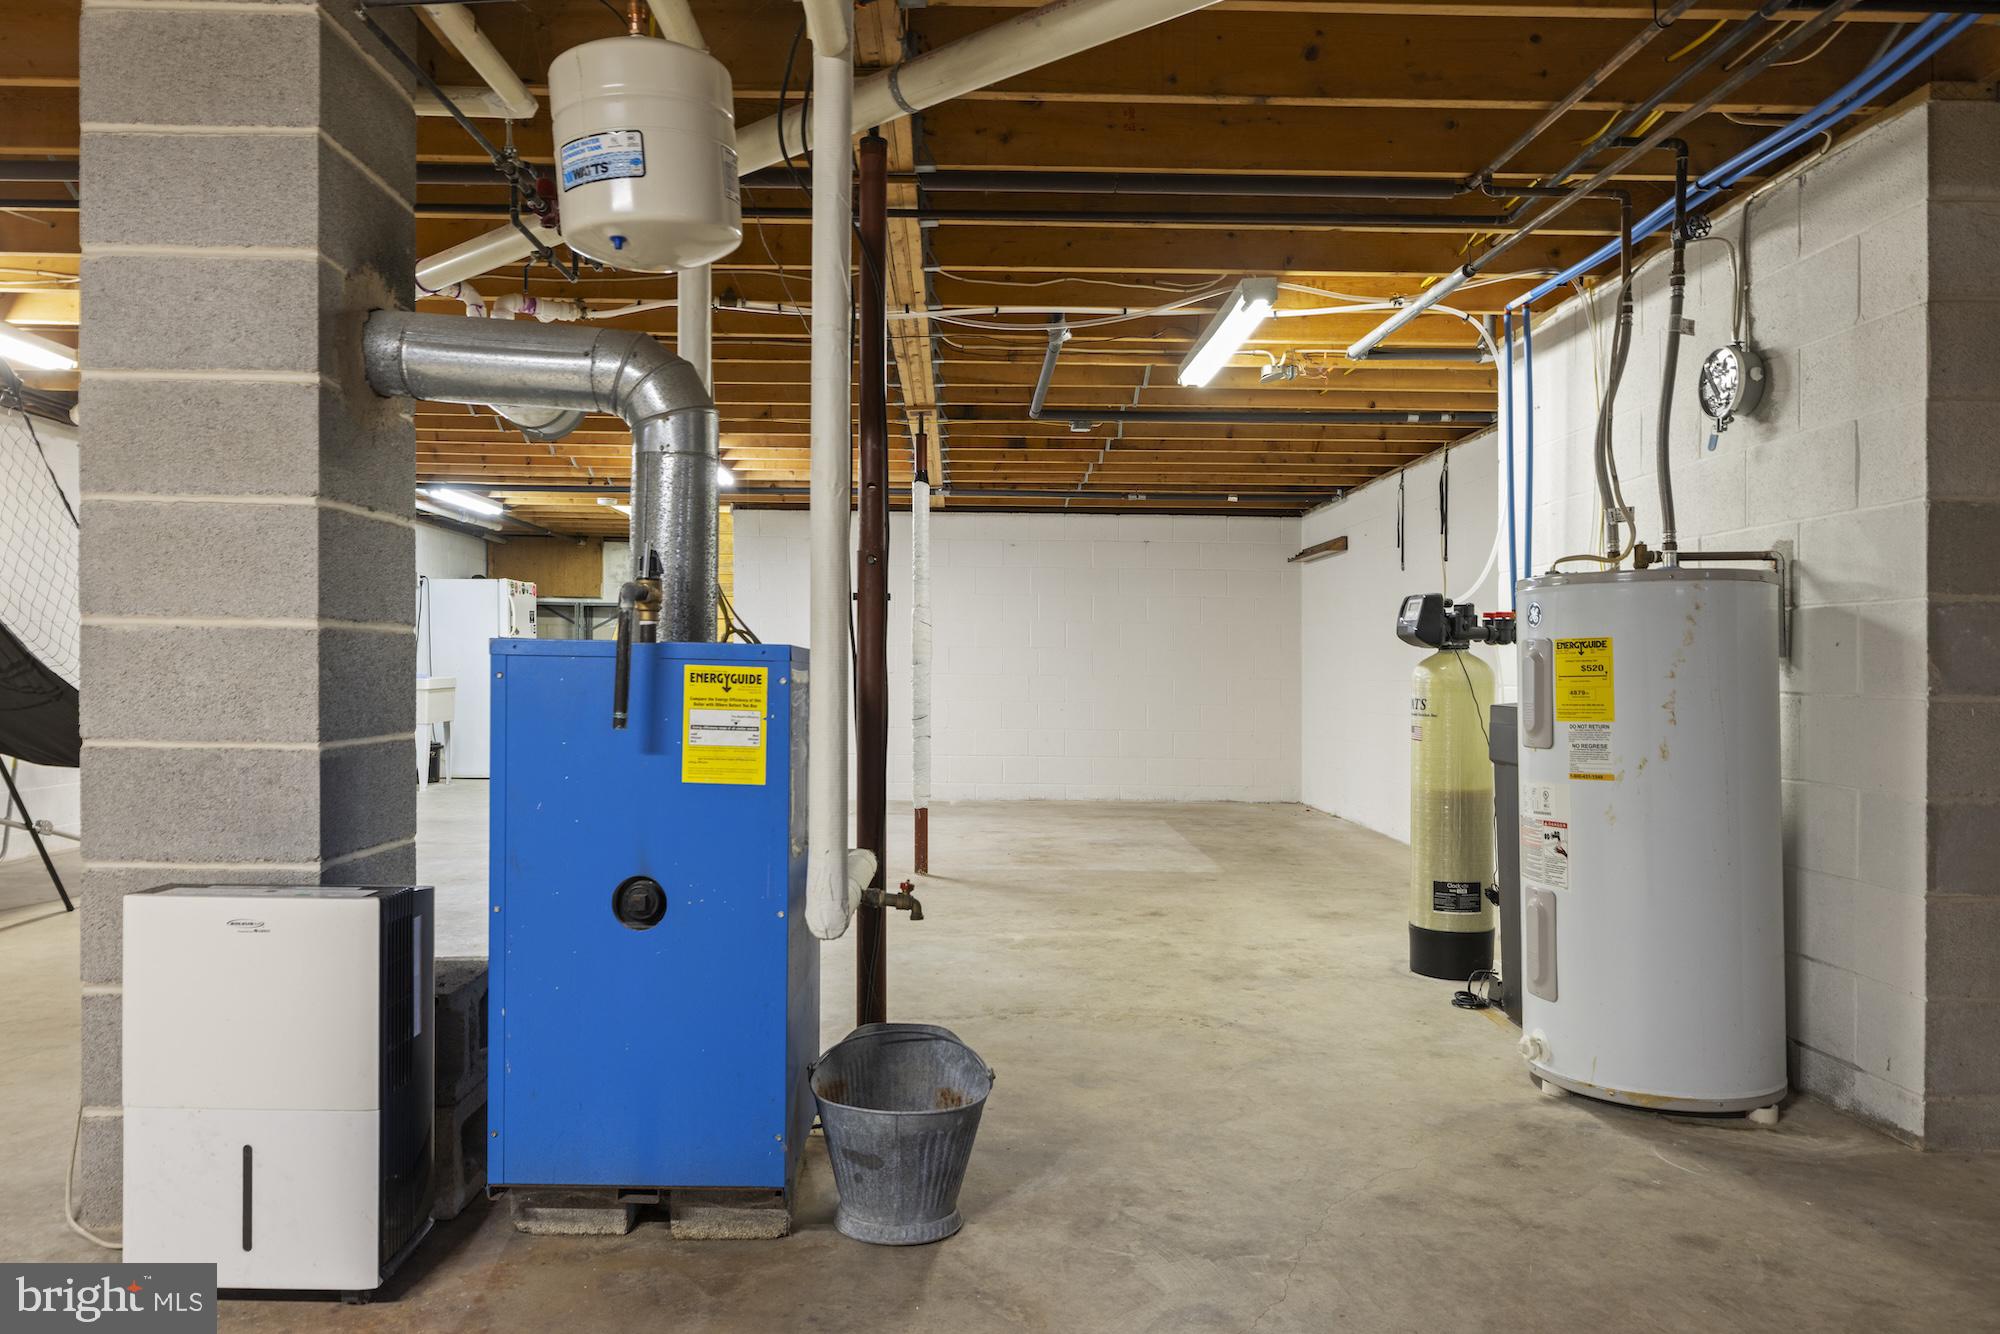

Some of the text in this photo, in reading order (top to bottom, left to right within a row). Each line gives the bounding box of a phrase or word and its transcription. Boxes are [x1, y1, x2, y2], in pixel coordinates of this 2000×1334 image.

[573, 162, 609, 180] WATTS
[1556, 640, 1607, 650] ENERGYGUIDE
[1580, 664, 1604, 672] $520
[689, 672, 762, 685] ENERGYGUIDE
